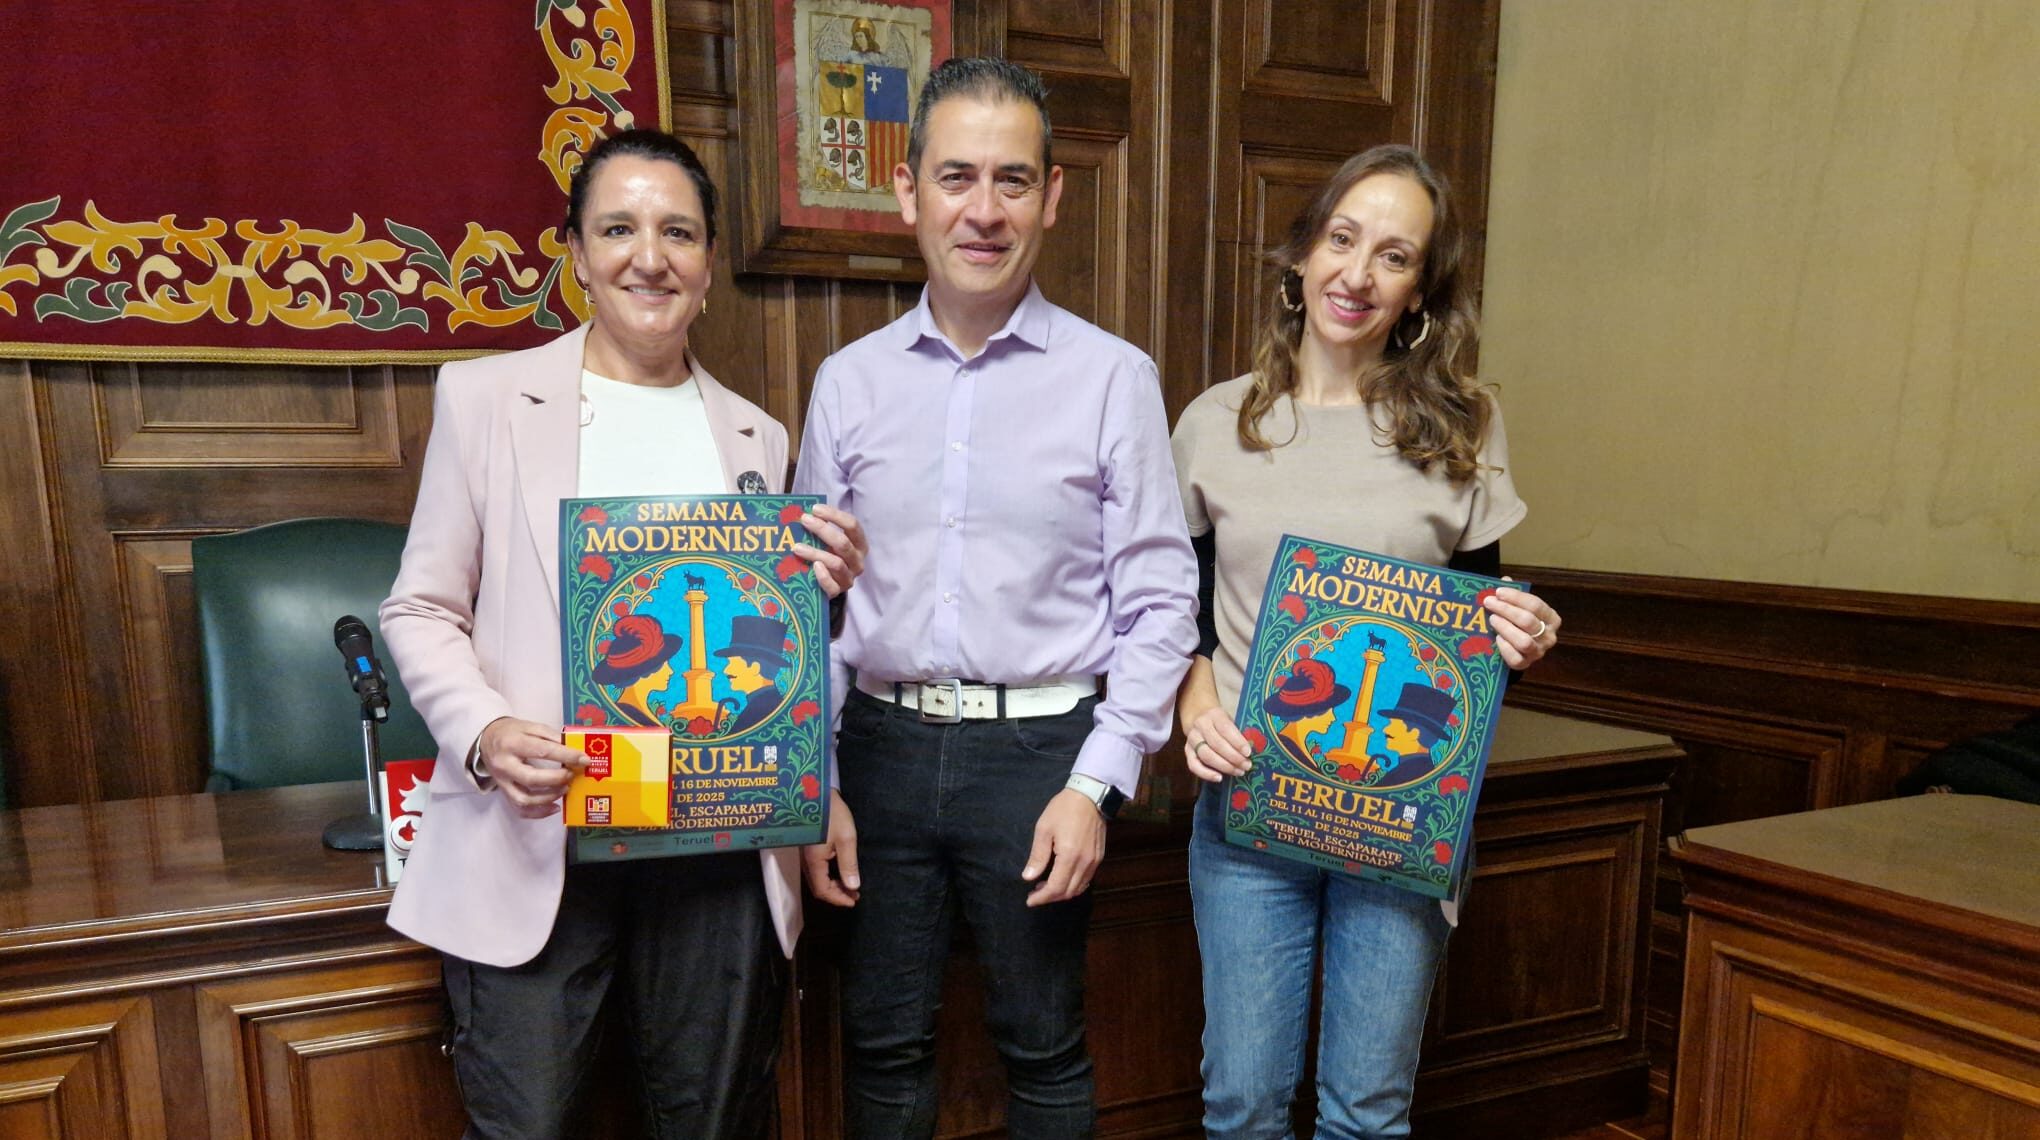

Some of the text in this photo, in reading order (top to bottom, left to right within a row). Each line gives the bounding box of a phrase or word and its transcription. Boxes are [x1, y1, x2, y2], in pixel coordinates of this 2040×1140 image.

[637, 501, 748, 522] SEMANA
[584, 525, 797, 553] MODERNISTA
[1342, 556, 1443, 596] SEMANA
[1288, 567, 1489, 634] MODERNISTA
[672, 746, 763, 775] RUEL
[681, 780, 694, 790] 16
[696, 779, 712, 790] DE
[713, 776, 779, 788] NOVIEMBRE
[677, 792, 725, 803] DE 2025
[1271, 772, 1401, 827] TERUEL
[690, 803, 773, 818] ESCAPARATE
[1269, 798, 1413, 843] DEL 11 AL 16 DE NOVIEMBRE
[673, 835, 714, 847] Teruel
[1277, 831, 1295, 844] DE
[1315, 821, 1360, 840] DE 2025
[1325, 835, 1403, 863] ESCAPARATE
